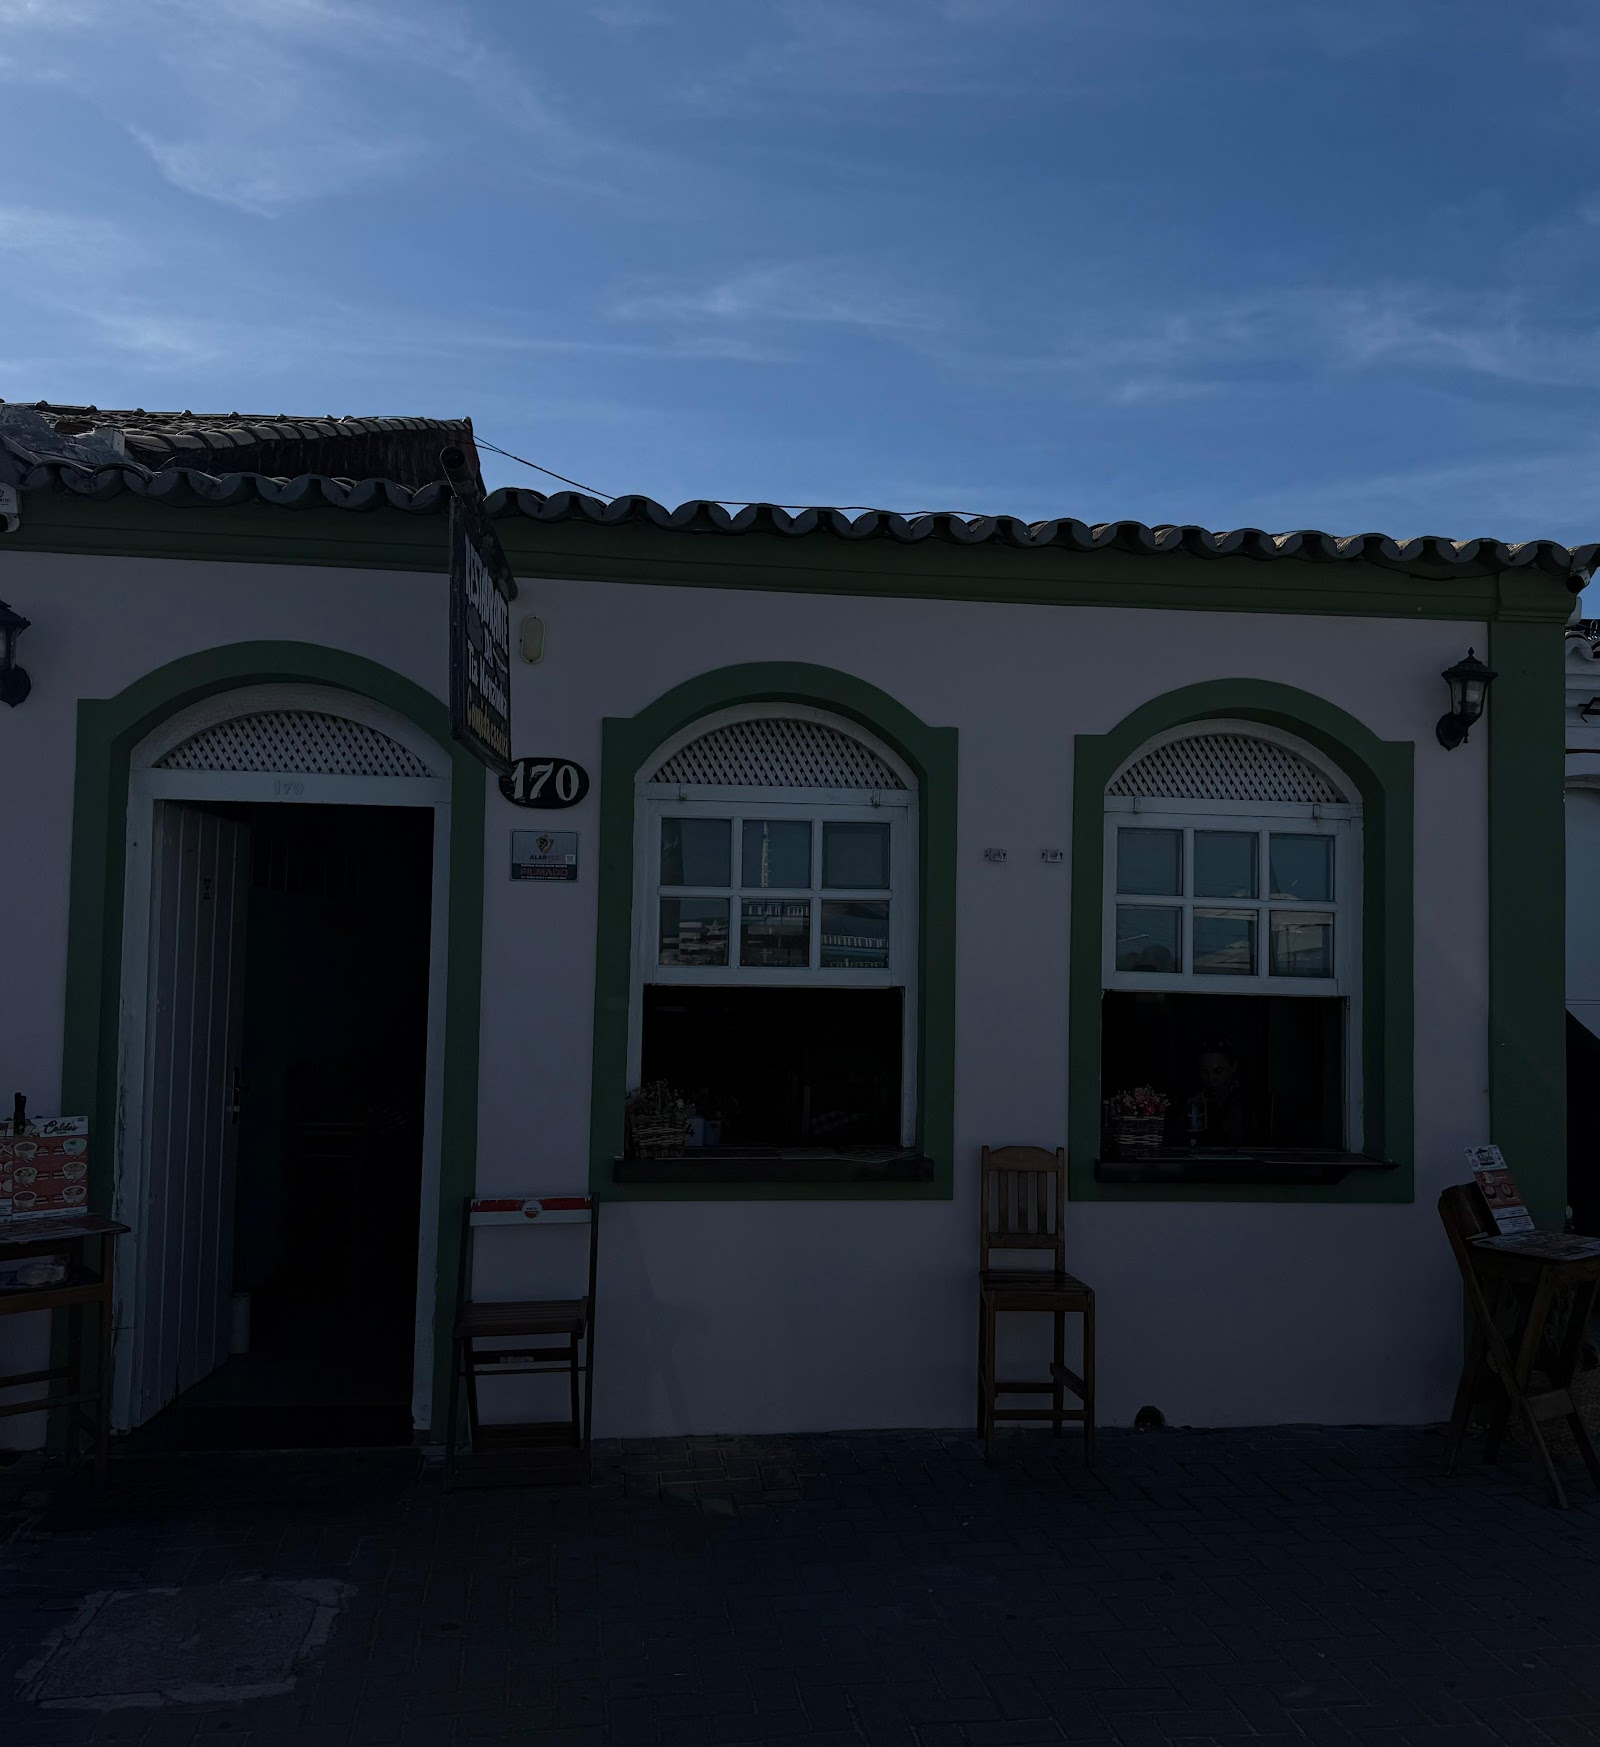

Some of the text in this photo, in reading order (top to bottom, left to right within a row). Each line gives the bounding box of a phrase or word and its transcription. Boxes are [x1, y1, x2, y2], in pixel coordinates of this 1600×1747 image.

[464, 533, 508, 656] RESTAURANTE
[467, 638, 479, 686] Tia
[510, 760, 580, 802] 170
[520, 868, 569, 877] FILMADO
